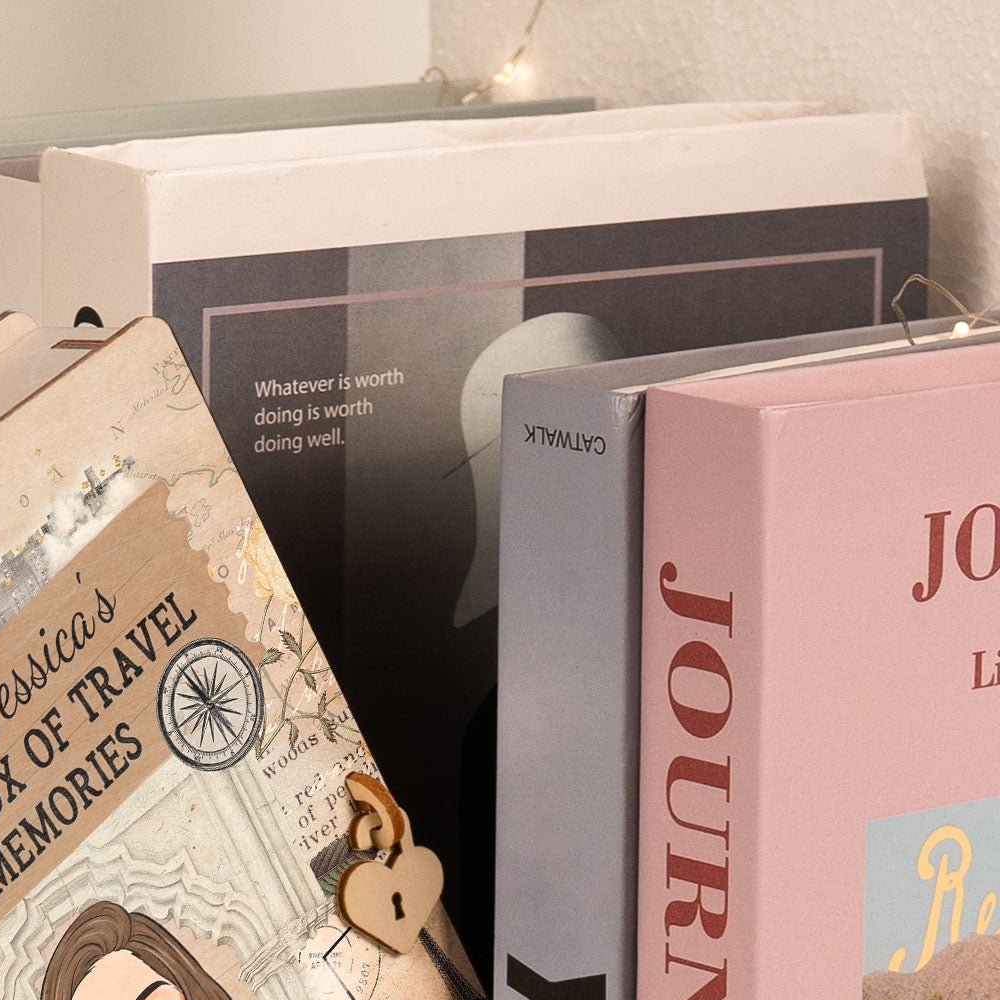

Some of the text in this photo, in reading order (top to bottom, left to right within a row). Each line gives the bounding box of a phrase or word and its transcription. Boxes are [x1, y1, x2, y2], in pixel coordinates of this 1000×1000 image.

[254, 367, 404, 398] Whatever is worth
[254, 397, 373, 427] doing is worth
[254, 427, 345, 454] doing well.
[524, 423, 607, 456] CATWALK
[912, 503, 1000, 603] JO
[23, 706, 70, 769] OF
[67, 592, 198, 723] TRAVEL
[297, 805, 318, 830] of
[299, 815, 338, 852] iver
